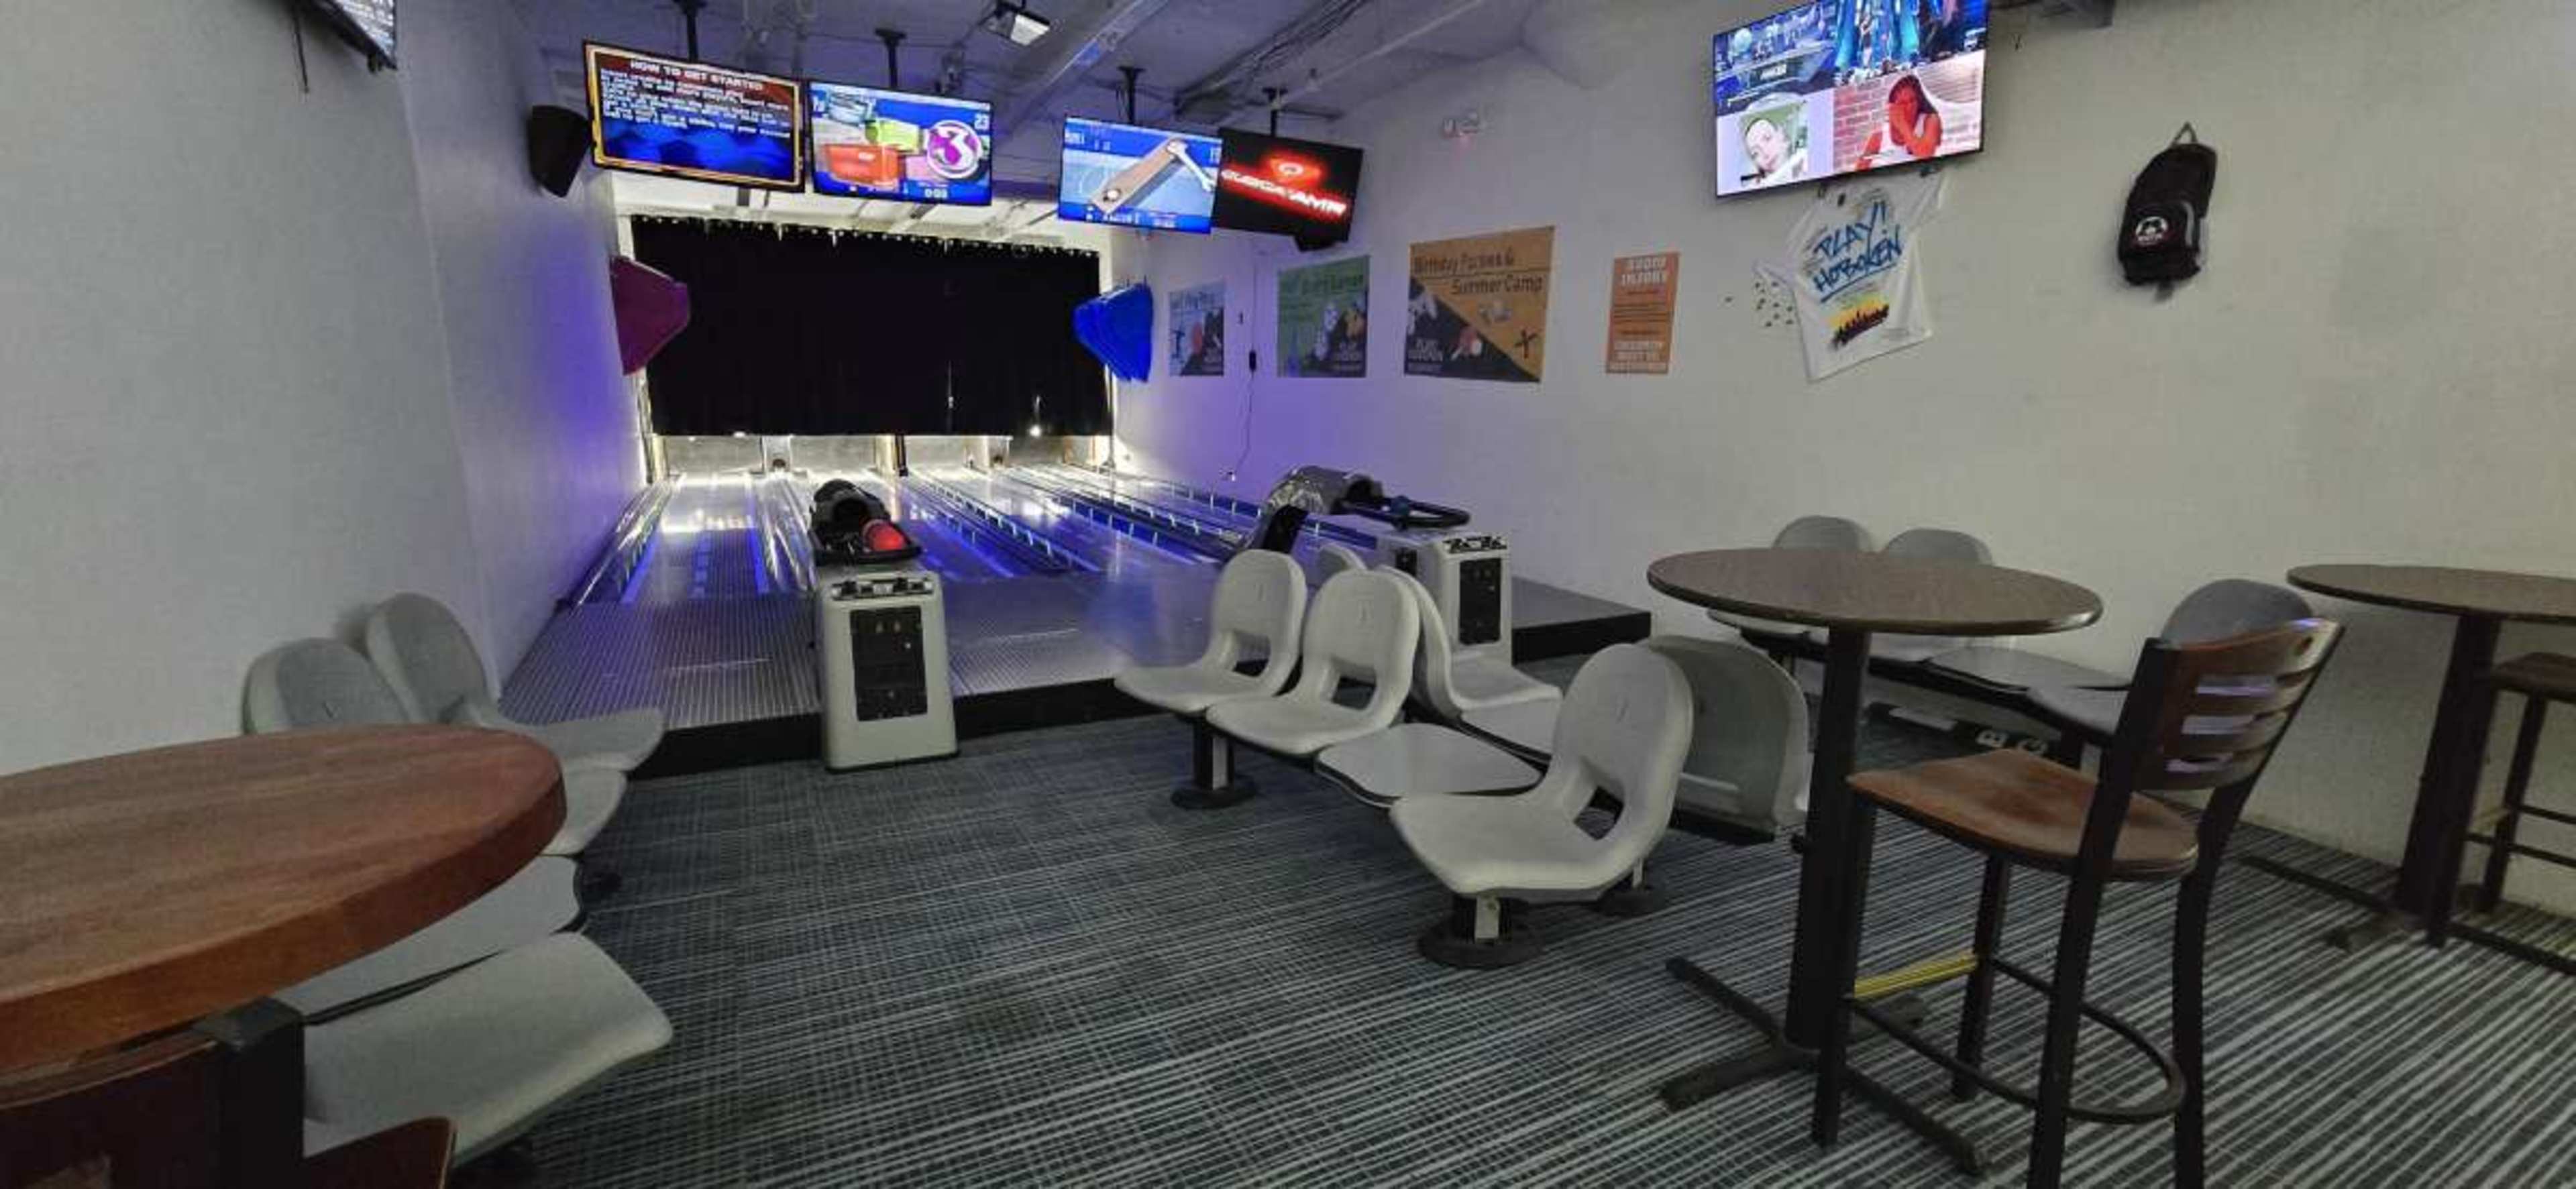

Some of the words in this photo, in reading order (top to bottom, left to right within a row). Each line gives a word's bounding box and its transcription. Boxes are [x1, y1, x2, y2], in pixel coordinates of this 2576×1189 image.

[631, 60, 660, 75] HOW
[663, 66, 682, 76] TO
[1451, 279, 1503, 295] Summer
[1505, 274, 1542, 292] Camp
